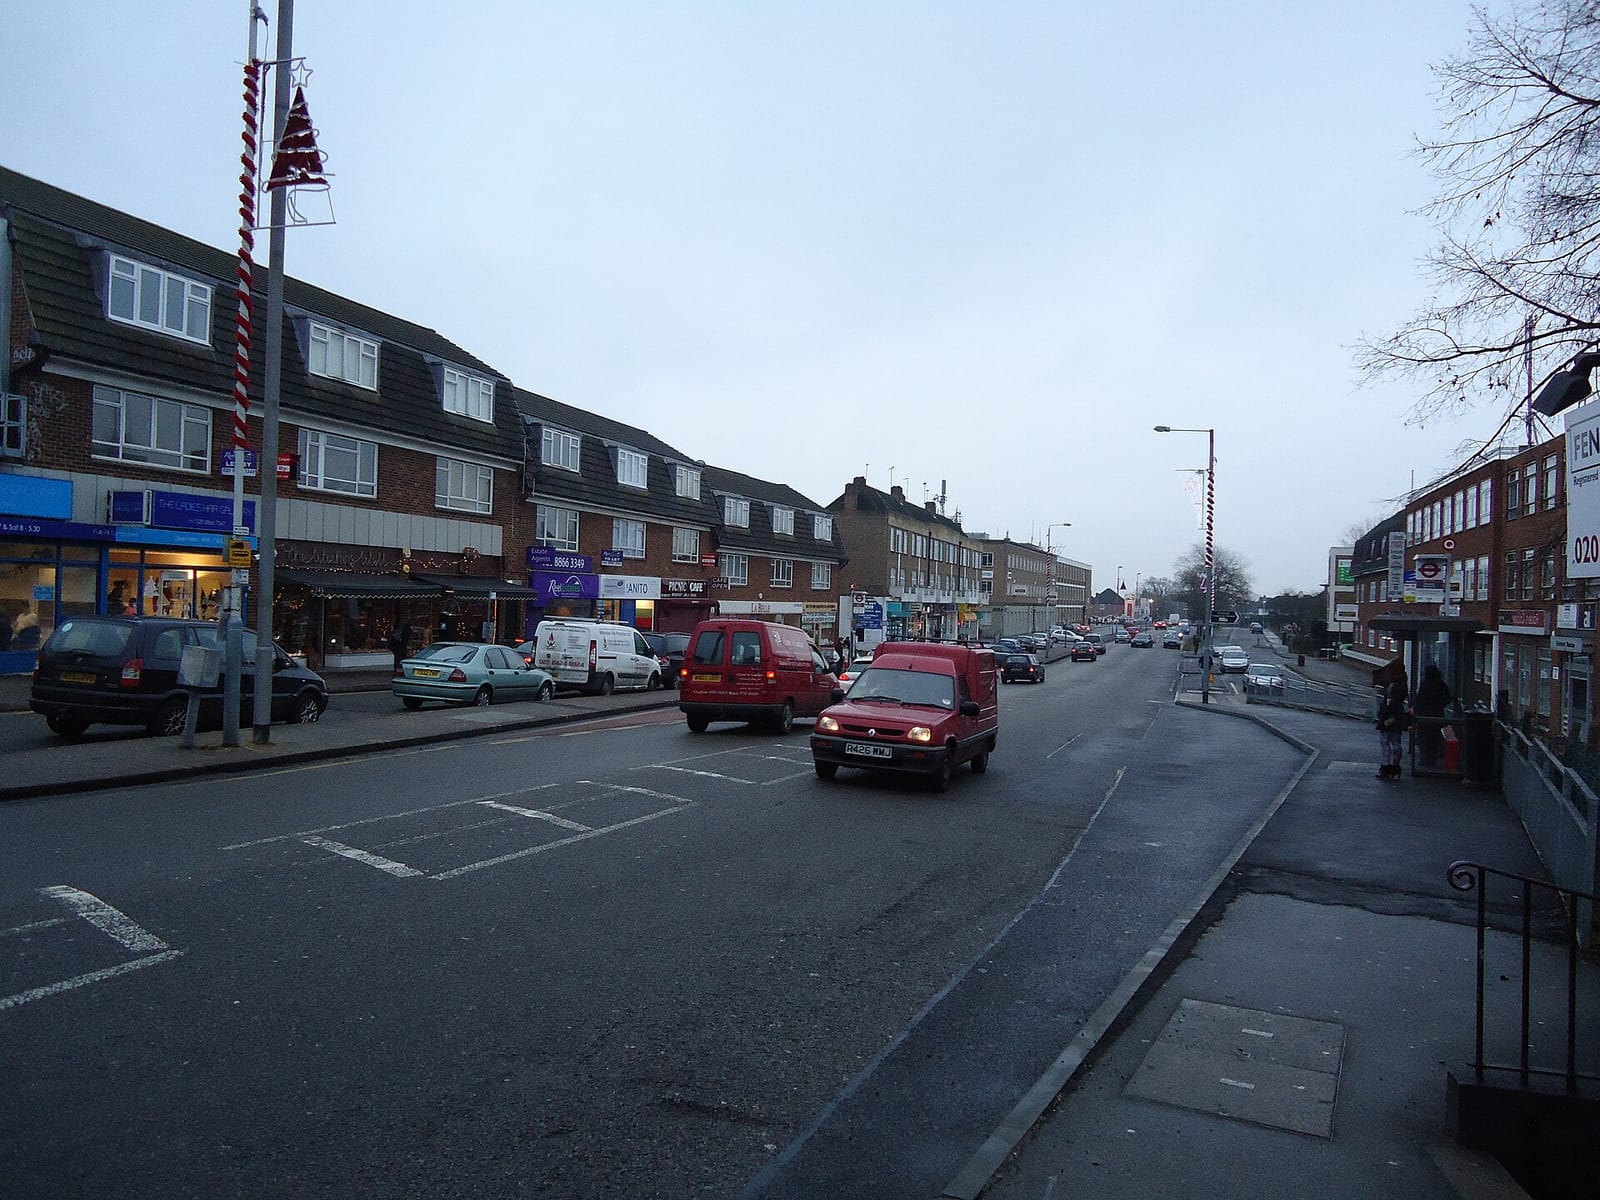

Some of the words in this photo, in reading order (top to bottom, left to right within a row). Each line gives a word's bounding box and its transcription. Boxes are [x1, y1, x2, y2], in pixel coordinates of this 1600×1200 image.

[1574, 427, 1600, 461] FEN
[1575, 535, 1599, 564] 020
[554, 556, 570, 568] 8866
[570, 557, 585, 569] 3349
[847, 745, 871, 754] R426
